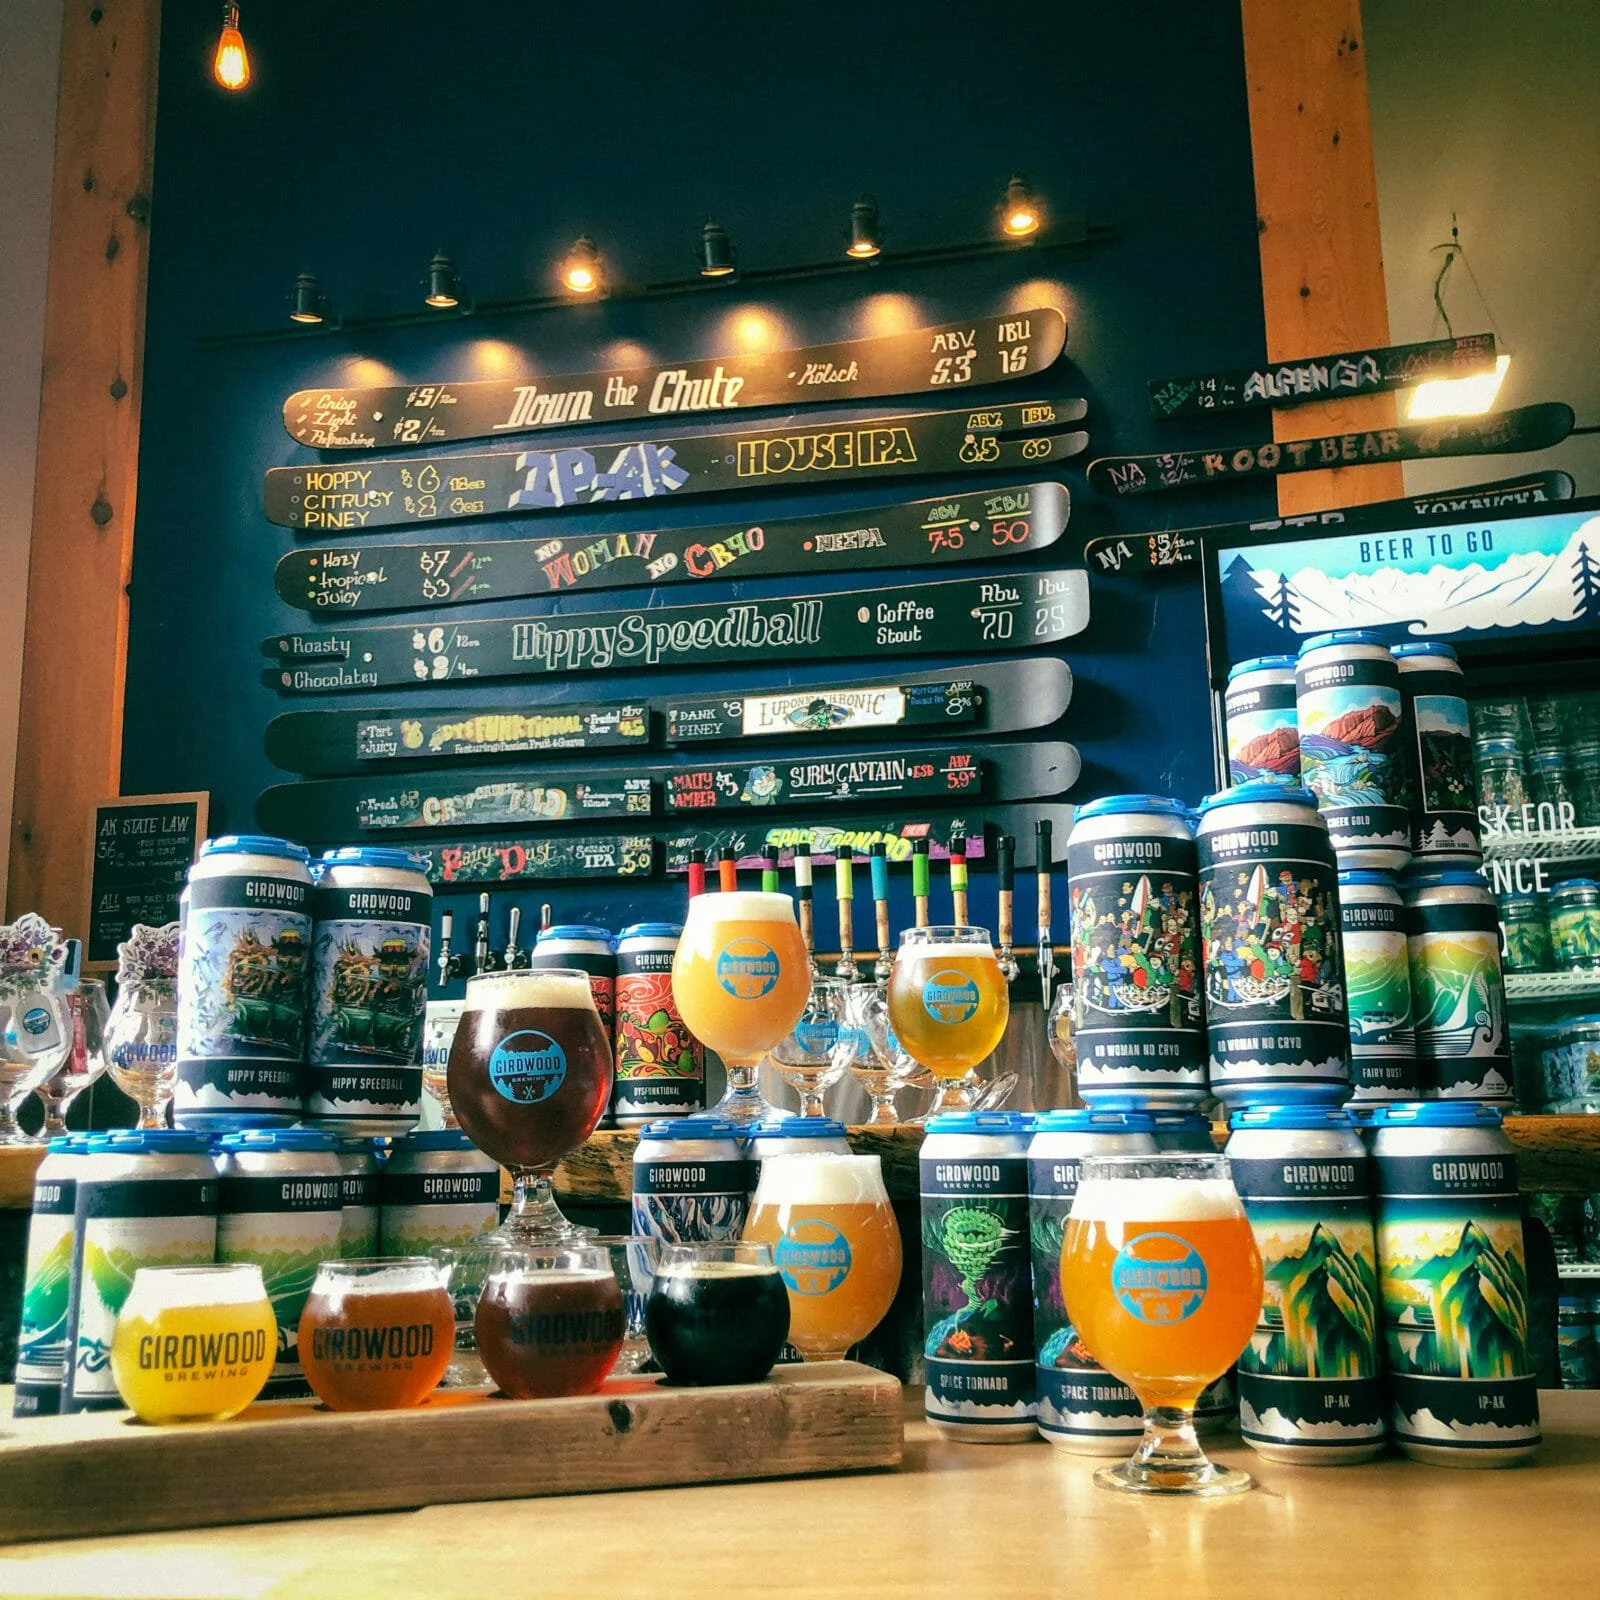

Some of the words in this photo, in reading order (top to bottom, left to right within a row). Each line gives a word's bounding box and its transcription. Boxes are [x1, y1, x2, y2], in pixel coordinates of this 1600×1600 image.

[998, 320, 1031, 343] IBU
[797, 362, 859, 385] Kölsch
[493, 386, 593, 429] Down
[604, 377, 639, 407] the
[648, 366, 744, 414] Chute
[312, 411, 358, 432] Light
[737, 432, 853, 477] HOUSE
[858, 428, 917, 467] IPA
[1022, 438, 1051, 459] 60
[306, 471, 373, 491] HOPPY
[1107, 463, 1145, 485] NA
[304, 490, 394, 510] CITRUSY
[984, 493, 1029, 515] IBU
[304, 511, 371, 528] PINEY
[992, 521, 1030, 546] 50
[534, 540, 564, 562] NO
[1360, 537, 1414, 563] BEER
[1427, 533, 1451, 558] TO
[1467, 529, 1493, 553] GO
[322, 551, 361, 570] Hazy
[541, 533, 657, 588] WOMAN
[646, 551, 678, 580] NO
[1096, 541, 1133, 571] NA
[877, 601, 934, 624] Coffee
[1035, 605, 1066, 636] 25
[877, 625, 922, 645] Stout
[292, 636, 350, 658] Roasty
[294, 668, 378, 689] Chocolatey
[680, 709, 716, 721] DANK
[367, 725, 393, 738] Tart
[678, 723, 724, 736] PINEY
[366, 740, 398, 756] Juicy
[836, 758, 905, 783] CAPTAIN
[674, 790, 717, 808] AMBER
[122, 818, 159, 834] STATE
[162, 816, 190, 833] LAW
[1477, 804, 1514, 839] SK
[1522, 801, 1576, 837] FOR
[1093, 842, 1162, 860] GIRDWOOD
[583, 853, 616, 869] IPA
[246, 882, 305, 901] GIRDWOOD
[349, 894, 411, 911] GIRDWOOD
[1342, 908, 1394, 922] GIRDWOOD
[635, 955, 673, 966] GIRDWOO
[1107, 1044, 1140, 1057] WOMAN
[1143, 1044, 1156, 1056] NO
[1158, 1044, 1180, 1056] CRYO
[1262, 1036, 1275, 1049] NO
[1278, 1036, 1302, 1049] CRYO
[495, 1056, 560, 1074] GIRDWOOD
[1362, 1068, 1383, 1078] FAIRY
[228, 1070, 254, 1082] HIPPY
[332, 1077, 356, 1089] HIPPY
[360, 1078, 403, 1091] SPEEDBALL
[649, 1167, 706, 1182] GIRDWOOD
[936, 1165, 1000, 1183] GIRDWOOD
[1283, 1165, 1355, 1184] GIRDWOOD
[1432, 1162, 1504, 1181] GIRDWOOD
[282, 1183, 338, 1200] GIRDWOOD
[424, 1178, 482, 1194] GIRDWOOD
[1119, 1268, 1201, 1286] GIRDWOOD
[139, 1328, 266, 1370] GIRDWOOD
[312, 1323, 434, 1361] GIRDWOOD
[164, 1367, 248, 1381] BREWING
[940, 1374, 965, 1390] SPACE
[967, 1376, 1008, 1391] TORNADO
[1061, 1385, 1089, 1400] SPACE
[1324, 1395, 1350, 1408] IP-AK
[1478, 1395, 1505, 1409] IP-AK
